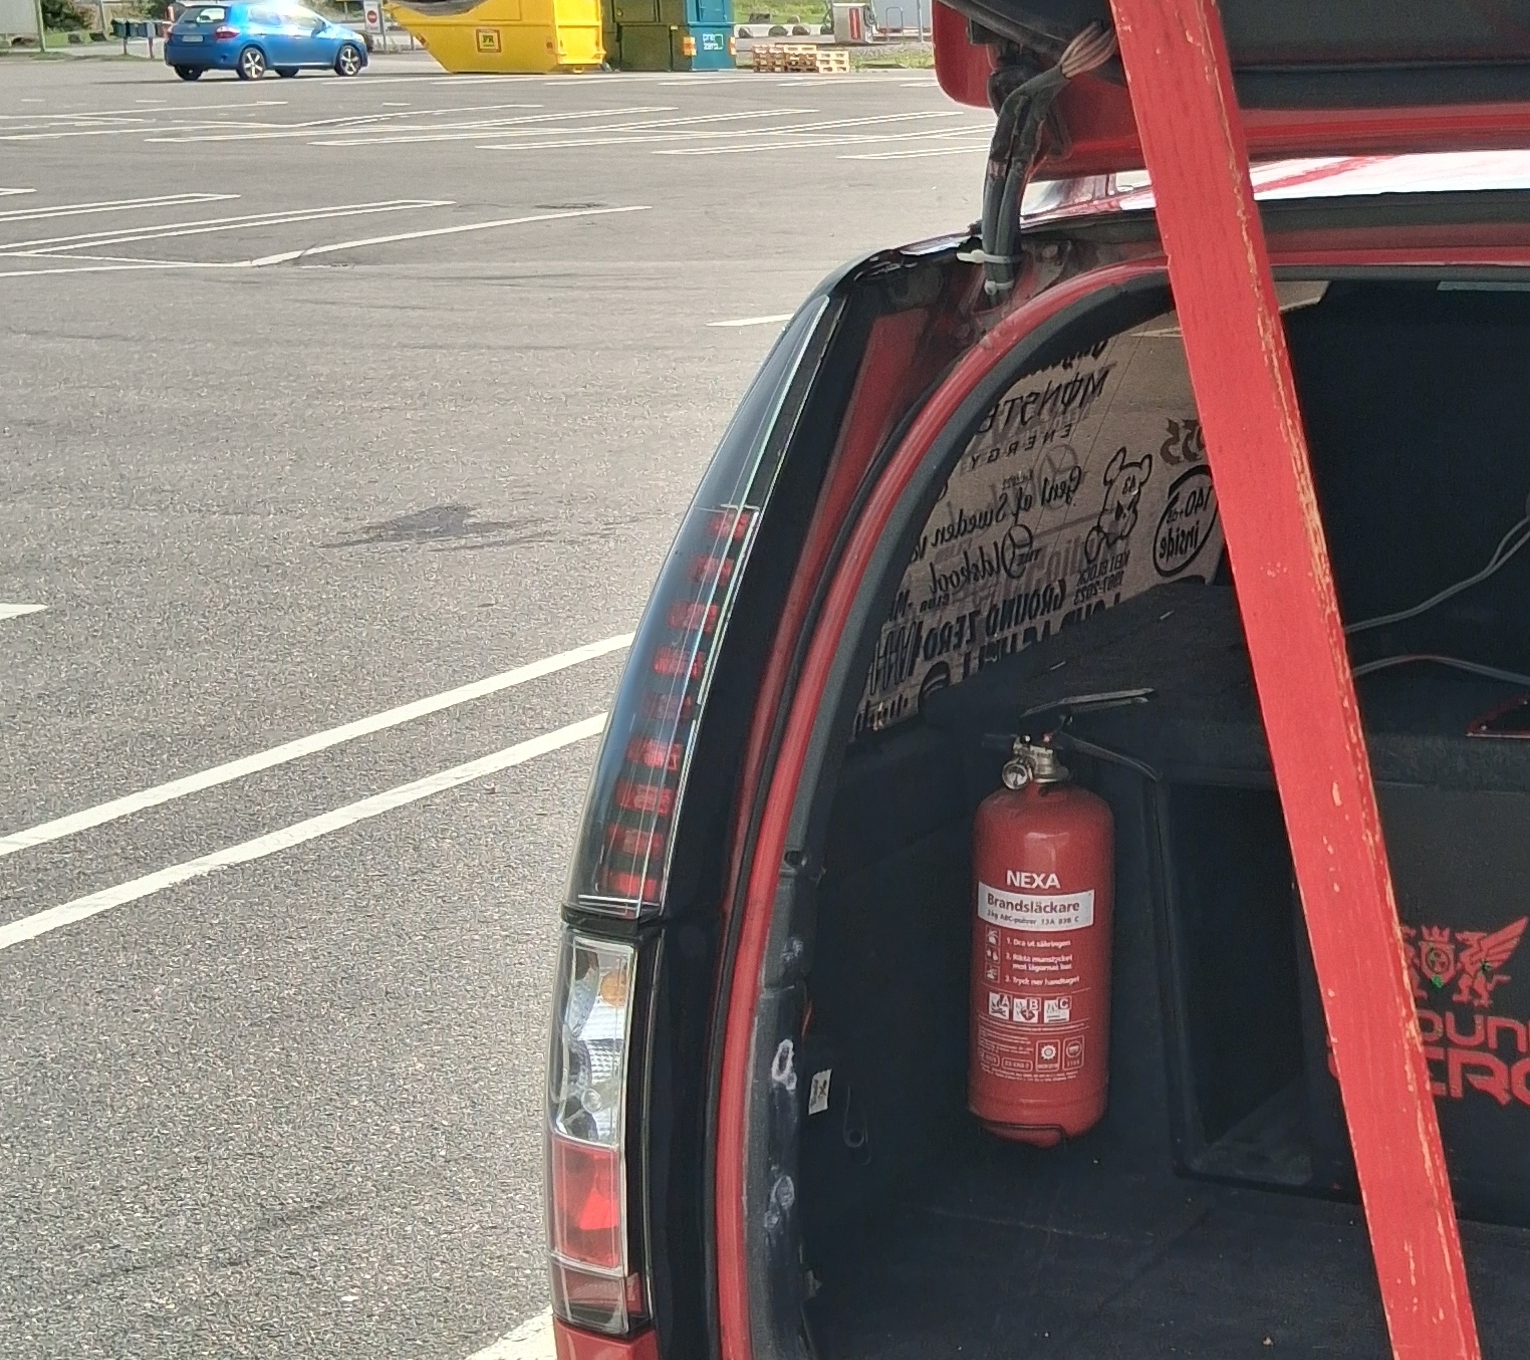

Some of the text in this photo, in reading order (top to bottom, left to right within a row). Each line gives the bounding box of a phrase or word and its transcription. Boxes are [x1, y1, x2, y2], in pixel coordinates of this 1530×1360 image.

[1006, 870, 1061, 889] NEXA
[987, 893, 1080, 914] Brandsläckare
[1000, 995, 1069, 1010] A B C
